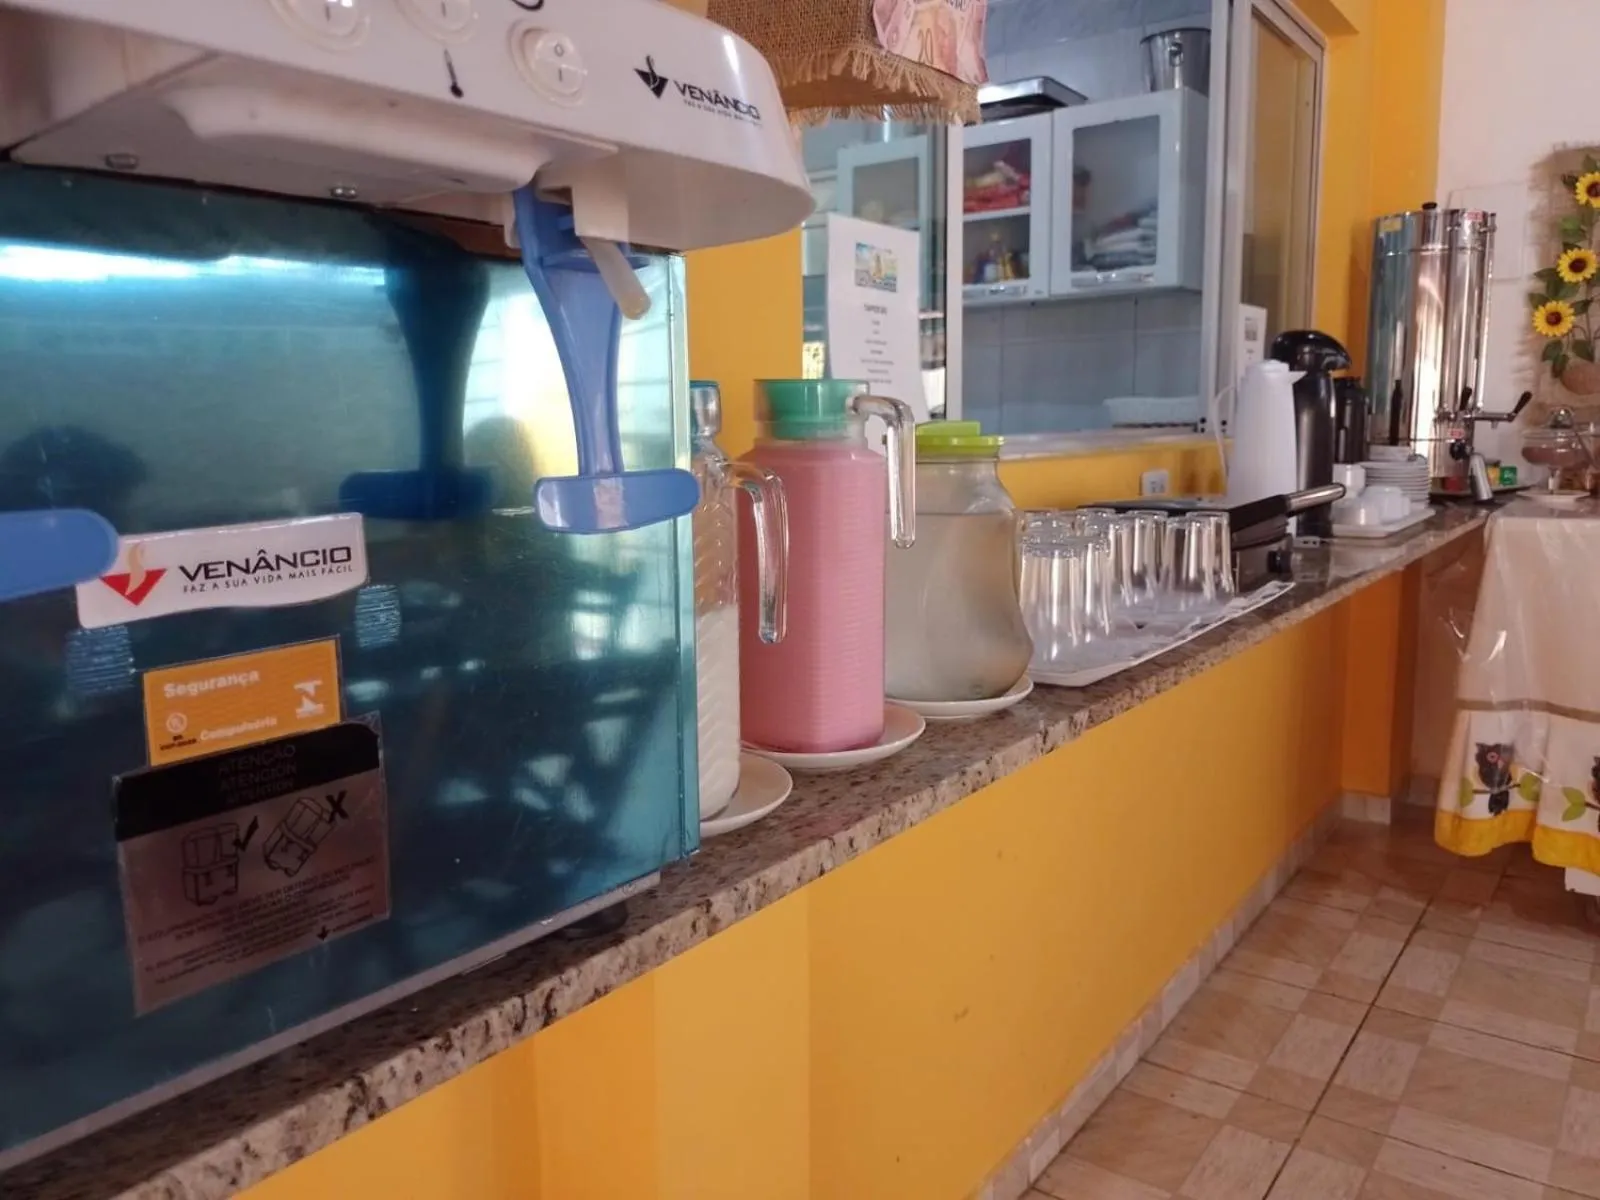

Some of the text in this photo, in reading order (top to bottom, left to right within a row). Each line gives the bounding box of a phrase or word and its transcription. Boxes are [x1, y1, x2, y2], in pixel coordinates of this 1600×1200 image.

[178, 546, 352, 582] VENÂNCIO
[183, 584, 206, 594] FAZ
[212, 582, 220, 590] A
[225, 579, 248, 588] SUA
[254, 574, 283, 585] VIDA
[289, 570, 317, 580] MAIS
[164, 670, 260, 699] Segurança
